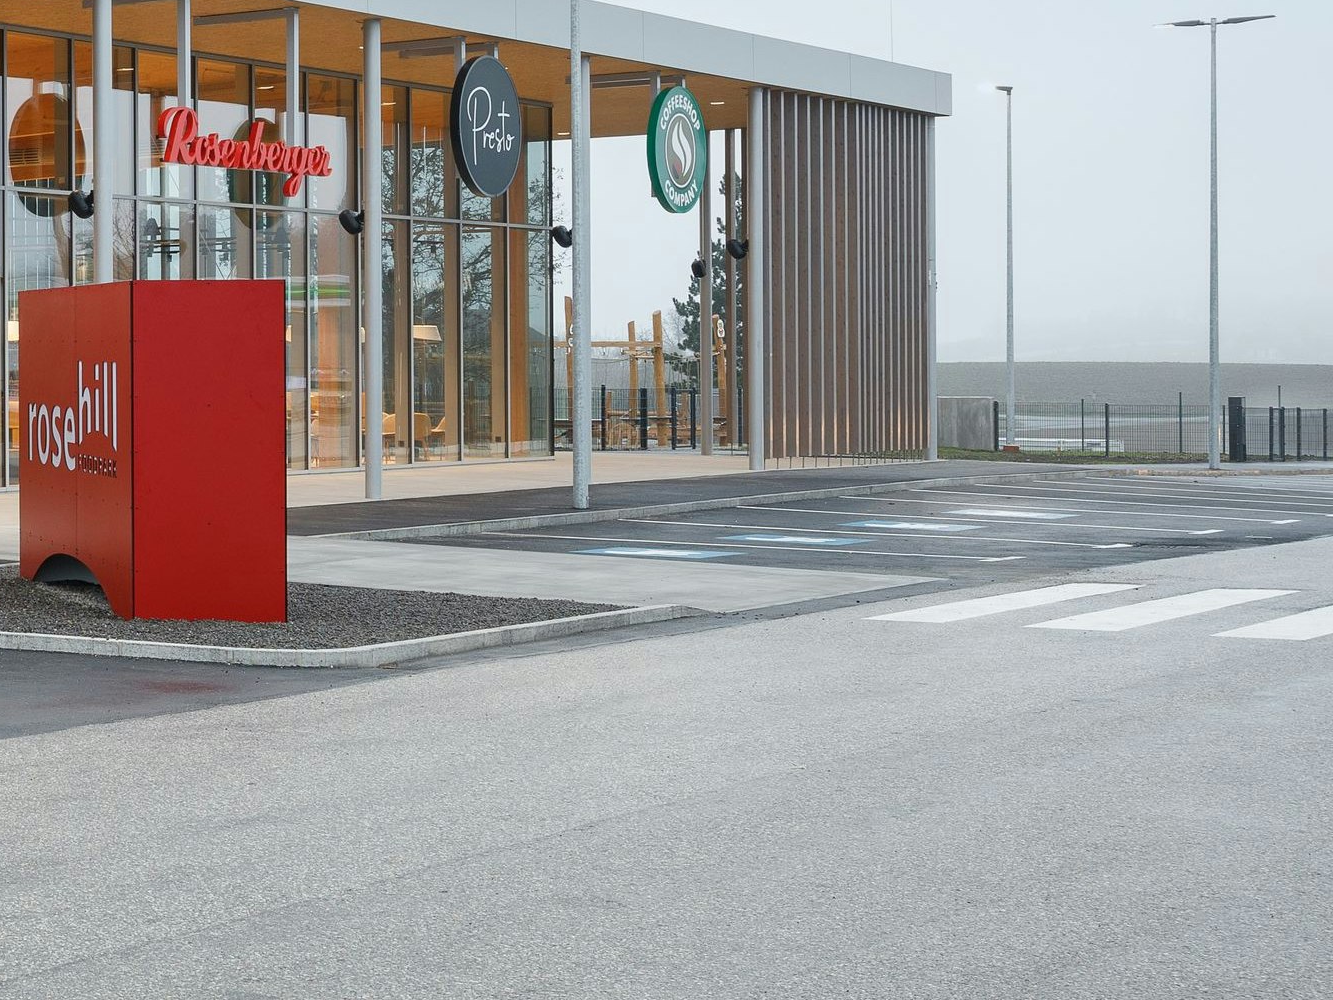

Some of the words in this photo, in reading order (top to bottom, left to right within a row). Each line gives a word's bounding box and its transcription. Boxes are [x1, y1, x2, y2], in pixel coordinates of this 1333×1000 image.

[466, 86, 515, 165] Presto
[660, 94, 700, 131] COFFEESHOP
[158, 106, 333, 198] Rosenberger
[664, 180, 698, 207] COMPANY
